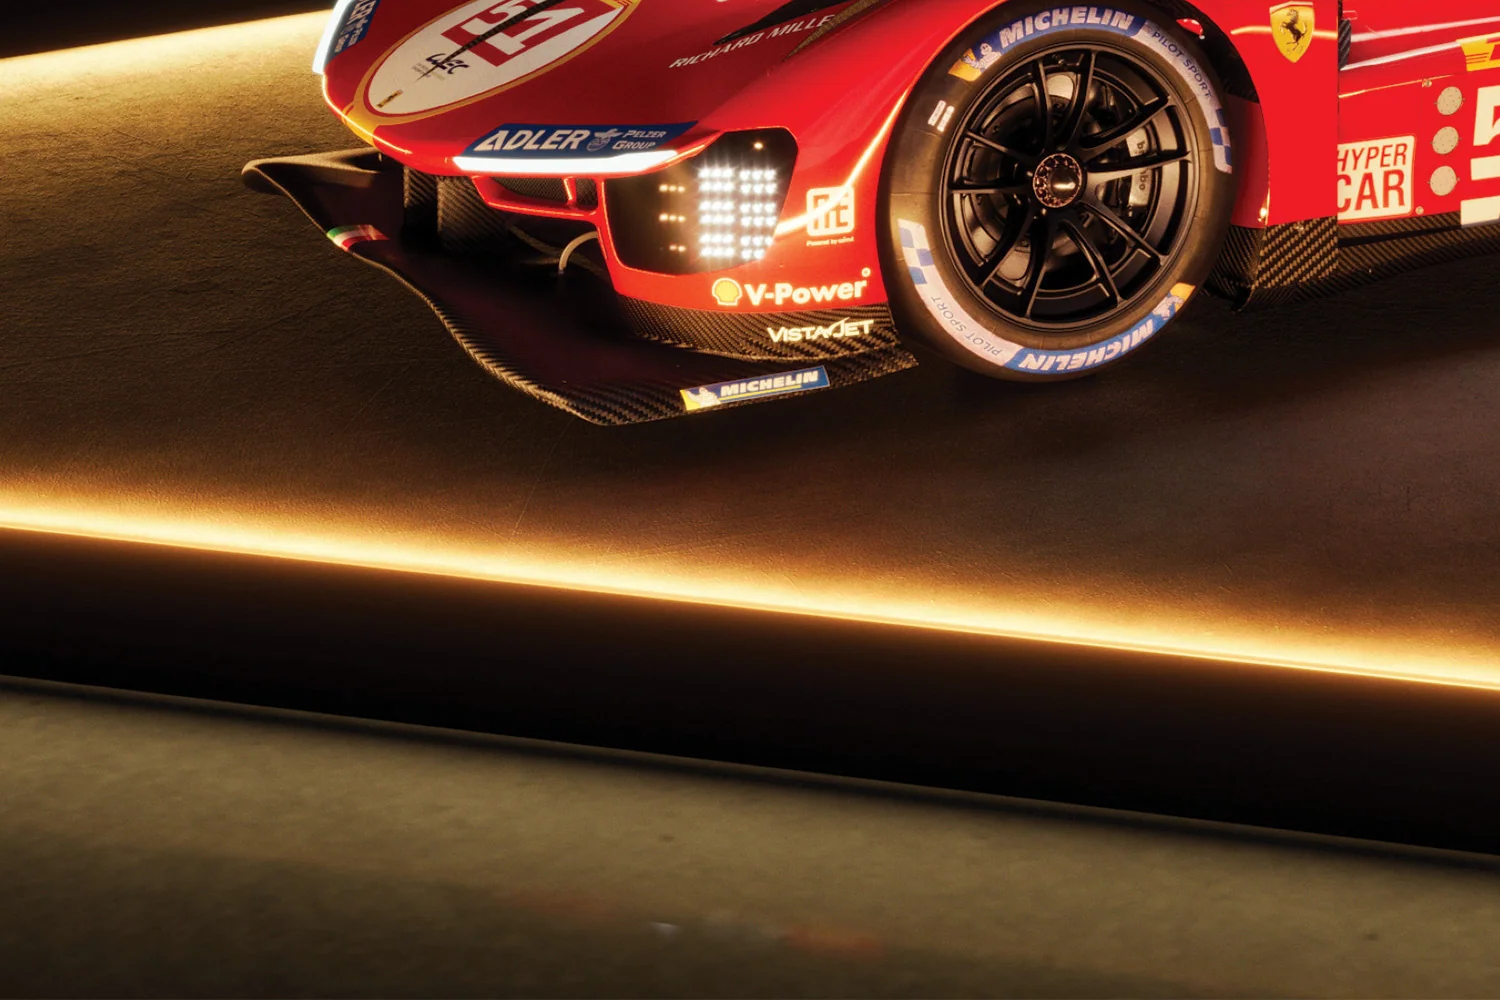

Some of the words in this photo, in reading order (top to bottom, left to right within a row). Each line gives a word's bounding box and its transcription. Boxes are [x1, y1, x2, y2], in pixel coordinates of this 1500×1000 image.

[669, 33, 763, 68] RICHARD
[765, 14, 835, 40] MILLE
[999, 6, 1134, 49] MICHELIN
[1152, 31, 1184, 59] PILOT
[1184, 58, 1213, 99] SPORT
[473, 129, 592, 152] ADLER
[622, 129, 666, 139] PELZER
[612, 140, 656, 150] GROUP
[1337, 143, 1408, 172] HYPER
[744, 279, 868, 306] V-Power
[931, 296, 966, 333] SPORT
[766, 317, 875, 343] VISTAJET
[964, 332, 1004, 356] PILOT
[1018, 318, 1154, 371] MICHELIN
[720, 370, 819, 397] MICHELIN
